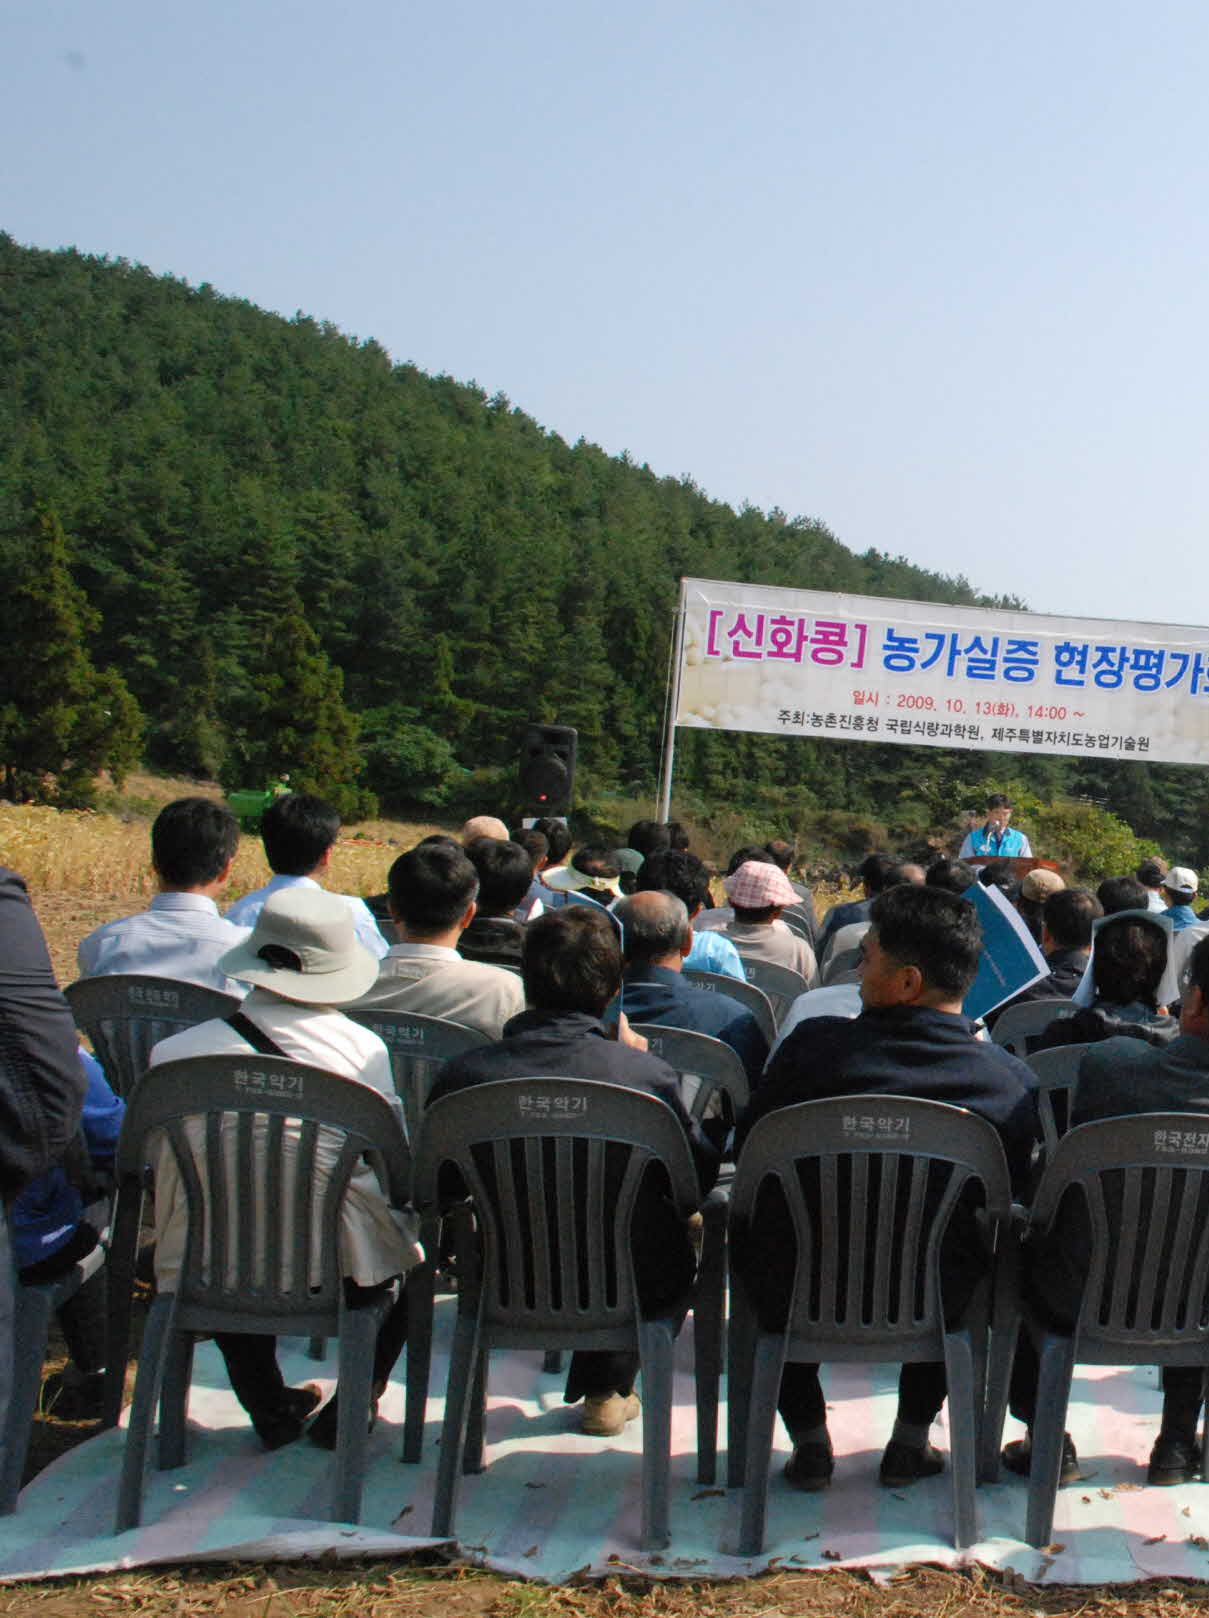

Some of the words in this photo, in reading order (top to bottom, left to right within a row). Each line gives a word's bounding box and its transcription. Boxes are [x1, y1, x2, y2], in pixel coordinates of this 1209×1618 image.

[706, 609, 868, 669] [신화콩]
[881, 627, 1040, 683] 농가실증
[852, 690, 879, 707] 일시
[897, 694, 937, 712] 2009.
[946, 699, 966, 714] 10.
[1027, 705, 1067, 720] 14:00
[777, 709, 879, 733] 주최:농촌진흥청
[991, 727, 1150, 752] 제주특별자치도농업기술원
[518, 1096, 588, 1112] 한국악기
[841, 1116, 911, 1132] 한국악기
